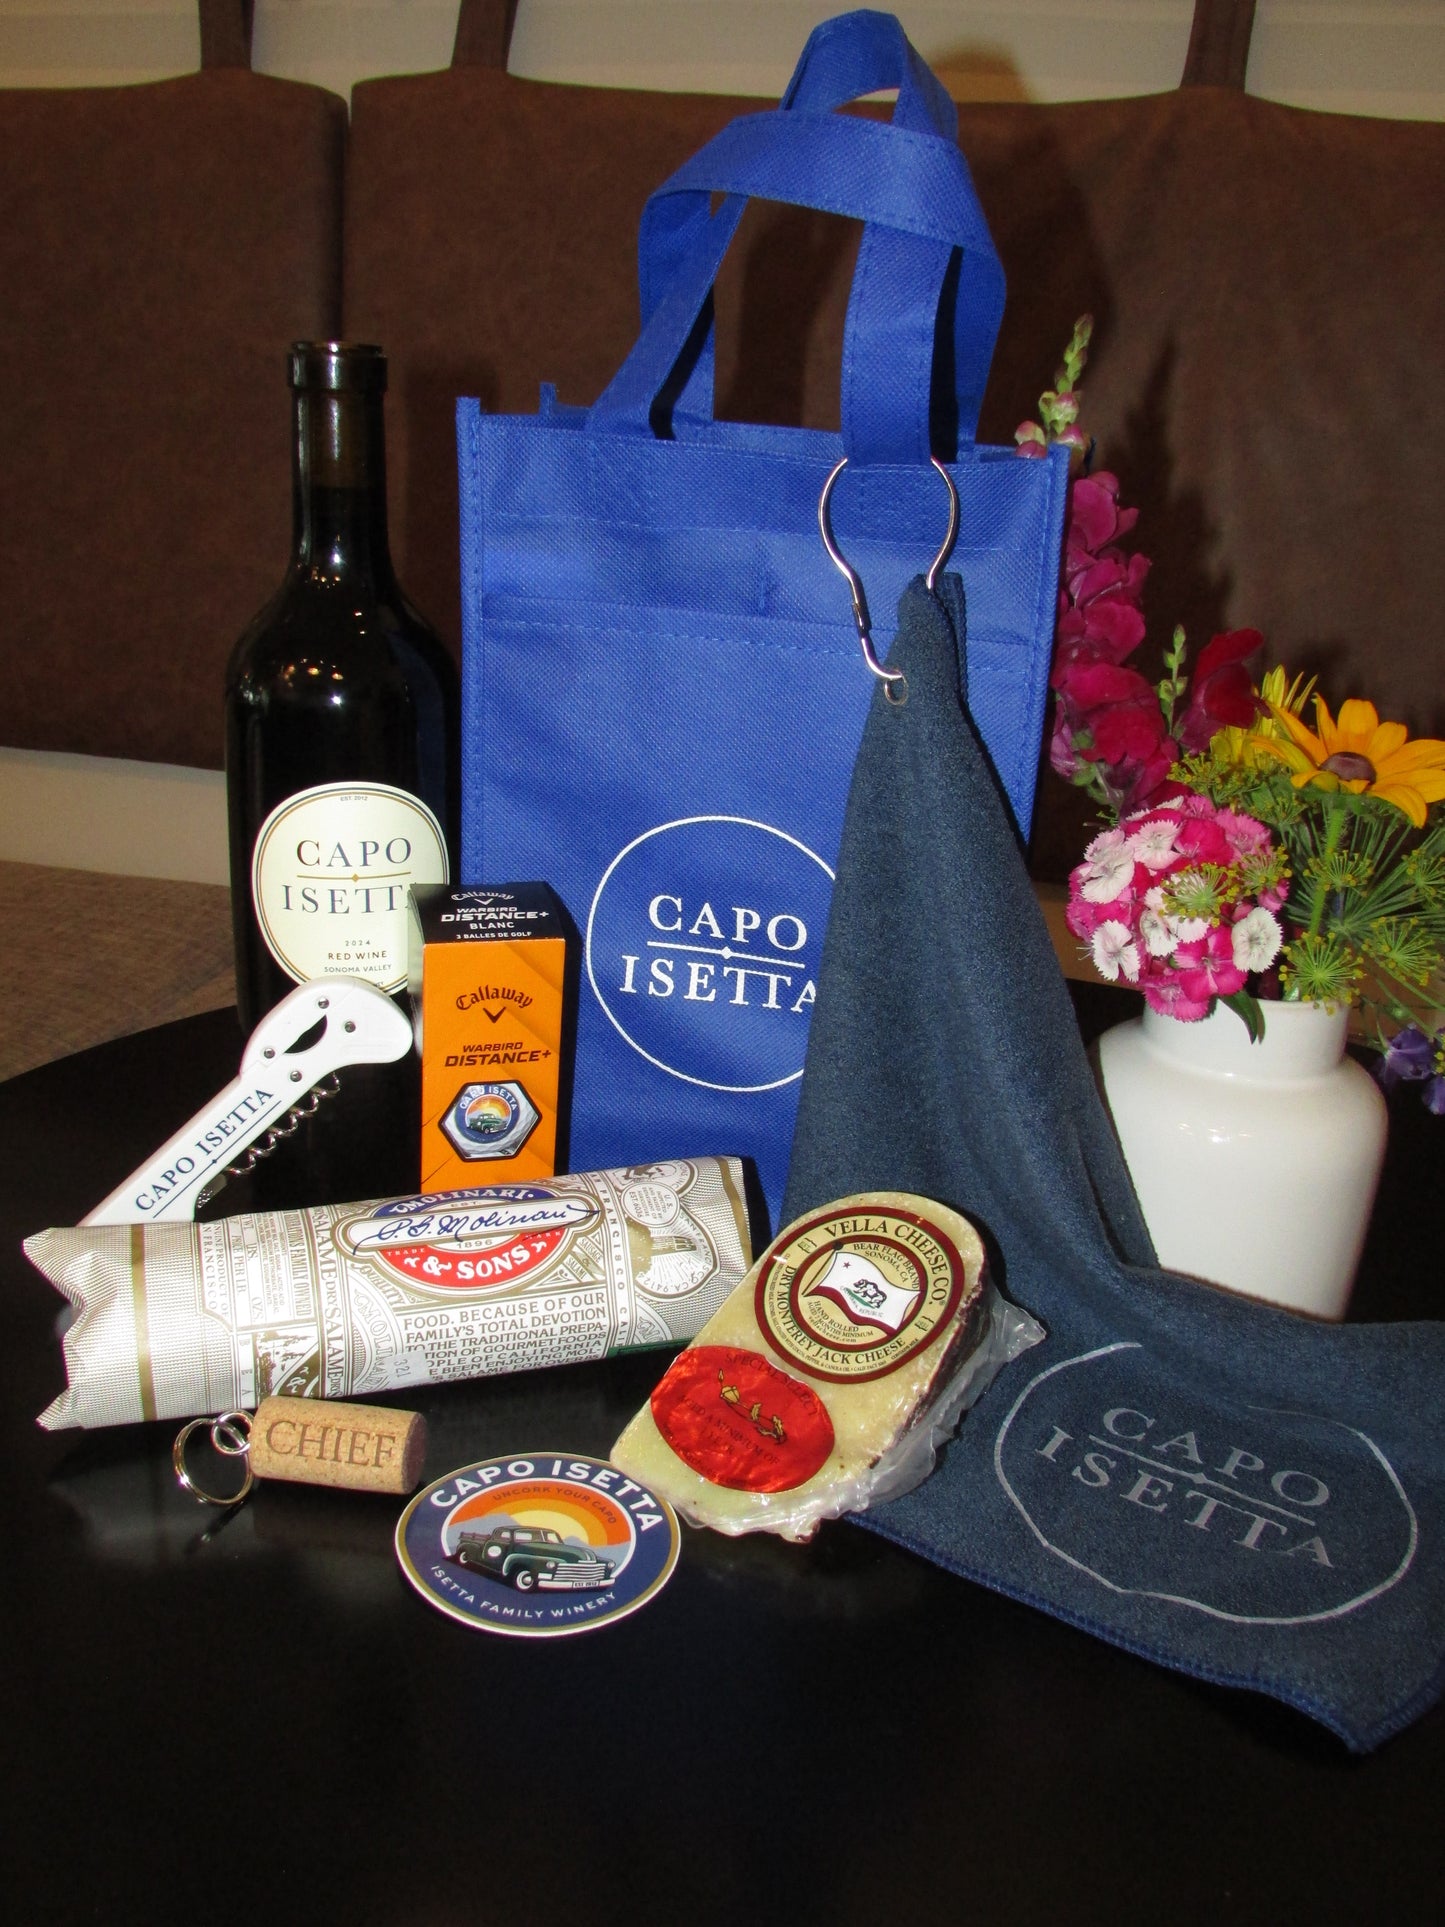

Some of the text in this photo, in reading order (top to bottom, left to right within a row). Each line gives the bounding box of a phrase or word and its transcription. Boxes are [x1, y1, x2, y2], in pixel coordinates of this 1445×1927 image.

[296, 837, 412, 868] CAPO
[281, 884, 410, 914] ISETT
[450, 890, 515, 901] Callaway
[440, 911, 550, 922] DISTANCE+
[469, 921, 516, 930] BLANC
[648, 894, 808, 951] CAPO
[328, 950, 388, 961] RED WINE
[345, 939, 371, 947] 2024
[363, 964, 393, 972] VALLEY
[619, 954, 817, 1013] ISETTA
[455, 984, 533, 1011] Callaway
[444, 1049, 552, 1067] DISTANCE+
[462, 1041, 524, 1053] WARBIRD
[488, 1087, 518, 1111] ISETTA
[135, 1088, 274, 1212] CAPO ISETTA
[388, 1188, 529, 1214] MOLINARI
[455, 1239, 493, 1249] 1896
[599, 1189, 626, 1291] FRANCISCO
[823, 1217, 889, 1239] VELLA
[893, 1222, 944, 1276] CHEESE
[203, 1235, 218, 1310] FRANCISCO
[215, 1248, 228, 1297] PRODUCT
[234, 1255, 245, 1276] PER
[290, 1248, 309, 1280] FAMILY
[422, 1245, 531, 1280] & SONS
[779, 1264, 797, 1289] DRY
[852, 1242, 921, 1289] BEAR FLAG BRAND
[864, 1250, 909, 1283] SONOMA, CA
[293, 1282, 312, 1316] OWNED
[403, 1292, 605, 1331] FOOD. BECAUSE OF OUR
[406, 1306, 606, 1344] FAMILY'S TOTAL DEVOTION
[776, 1291, 818, 1352] MONTEREY
[807, 1301, 874, 1338] AGED MONTHS MINIMUM
[813, 1300, 859, 1332] HAND ROLLED
[324, 1304, 344, 1378] SALAME
[427, 1340, 458, 1351] THE
[460, 1328, 558, 1348] TRADITIONAL
[560, 1321, 608, 1336] PREPA-
[463, 1346, 482, 1356] OF
[482, 1338, 559, 1353] GOURMET
[559, 1331, 607, 1345] FOODS
[476, 1353, 493, 1363] OF
[496, 1340, 602, 1360] CALIFORNIA
[854, 1337, 907, 1364] CHEESE
[445, 1362, 482, 1374] BEEN
[485, 1352, 564, 1370] ENJOYING
[566, 1347, 600, 1359] MOL-
[512, 1361, 542, 1371] FOR
[812, 1346, 852, 1366] JACK
[265, 1420, 397, 1468] CHIEF
[1102, 1406, 1331, 1508] CAPO
[430, 1460, 535, 1508] CAPO
[550, 1459, 664, 1533] ISETTA
[492, 1485, 617, 1525] UNCORK YOUR CAPO
[1034, 1425, 1335, 1569] ISETTA
[430, 1565, 617, 1619] ISETTA FAMILY WINERY
